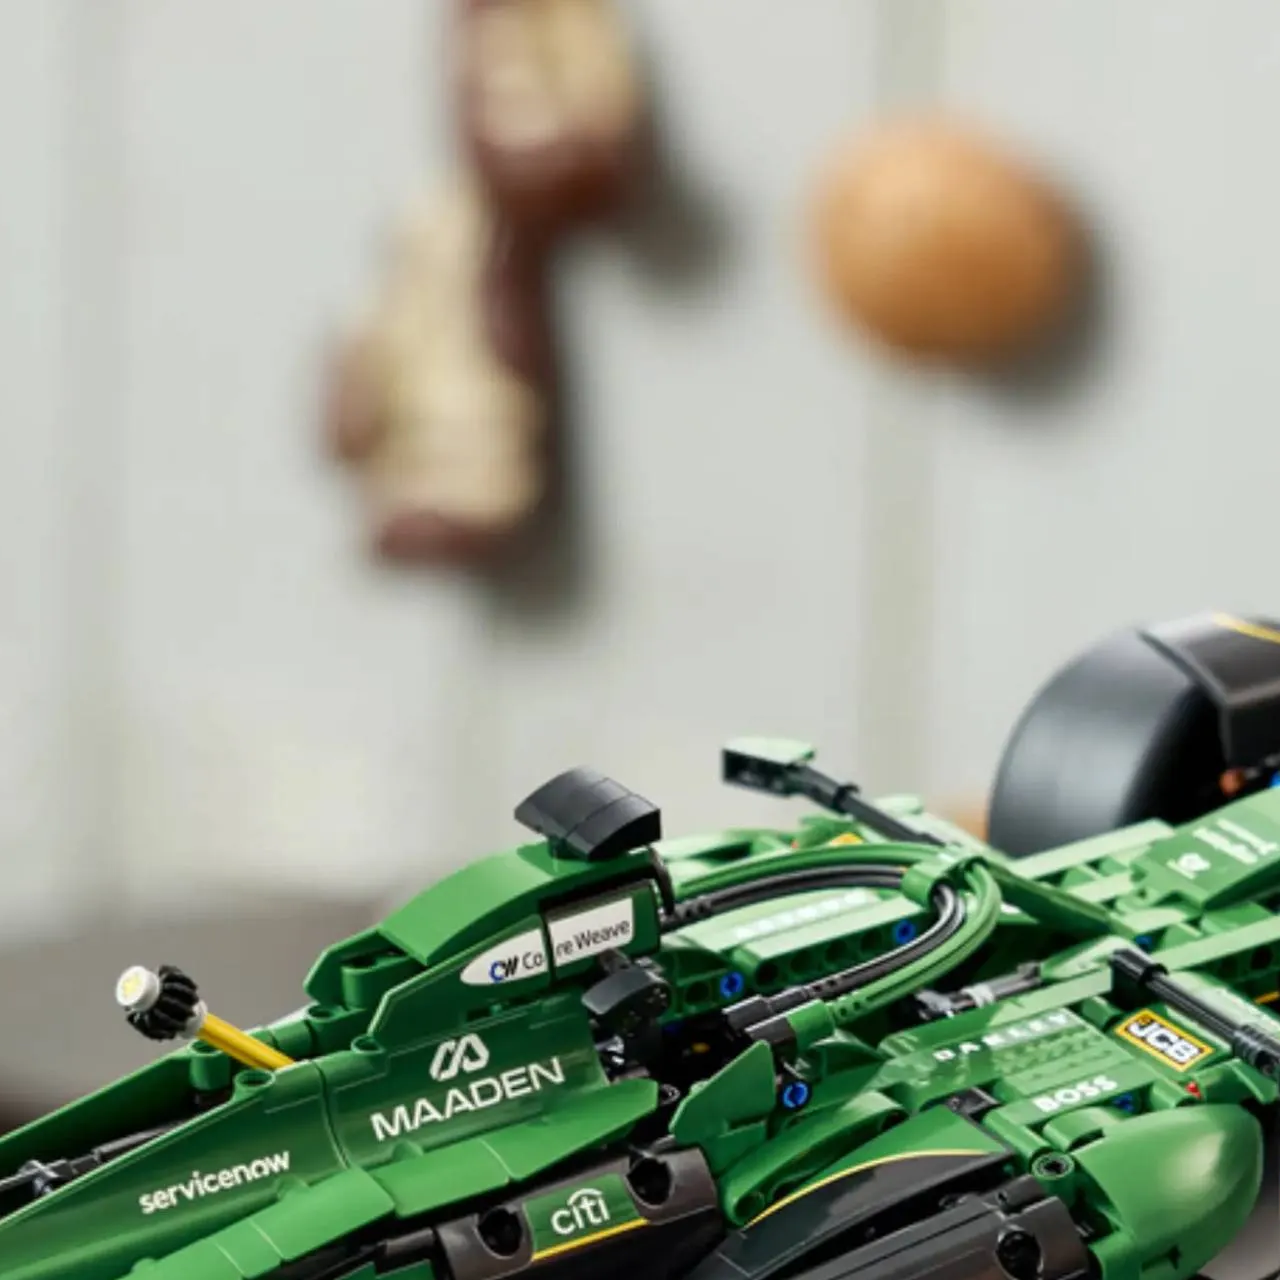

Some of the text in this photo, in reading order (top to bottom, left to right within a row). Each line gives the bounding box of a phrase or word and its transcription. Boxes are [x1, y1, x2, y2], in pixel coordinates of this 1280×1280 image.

[1126, 1018, 1201, 1065] JCB
[369, 1056, 565, 1141] MAADEN
[1033, 1074, 1118, 1113] BOSS
[139, 1151, 290, 1215] servicenow
[550, 1188, 610, 1235] citi
